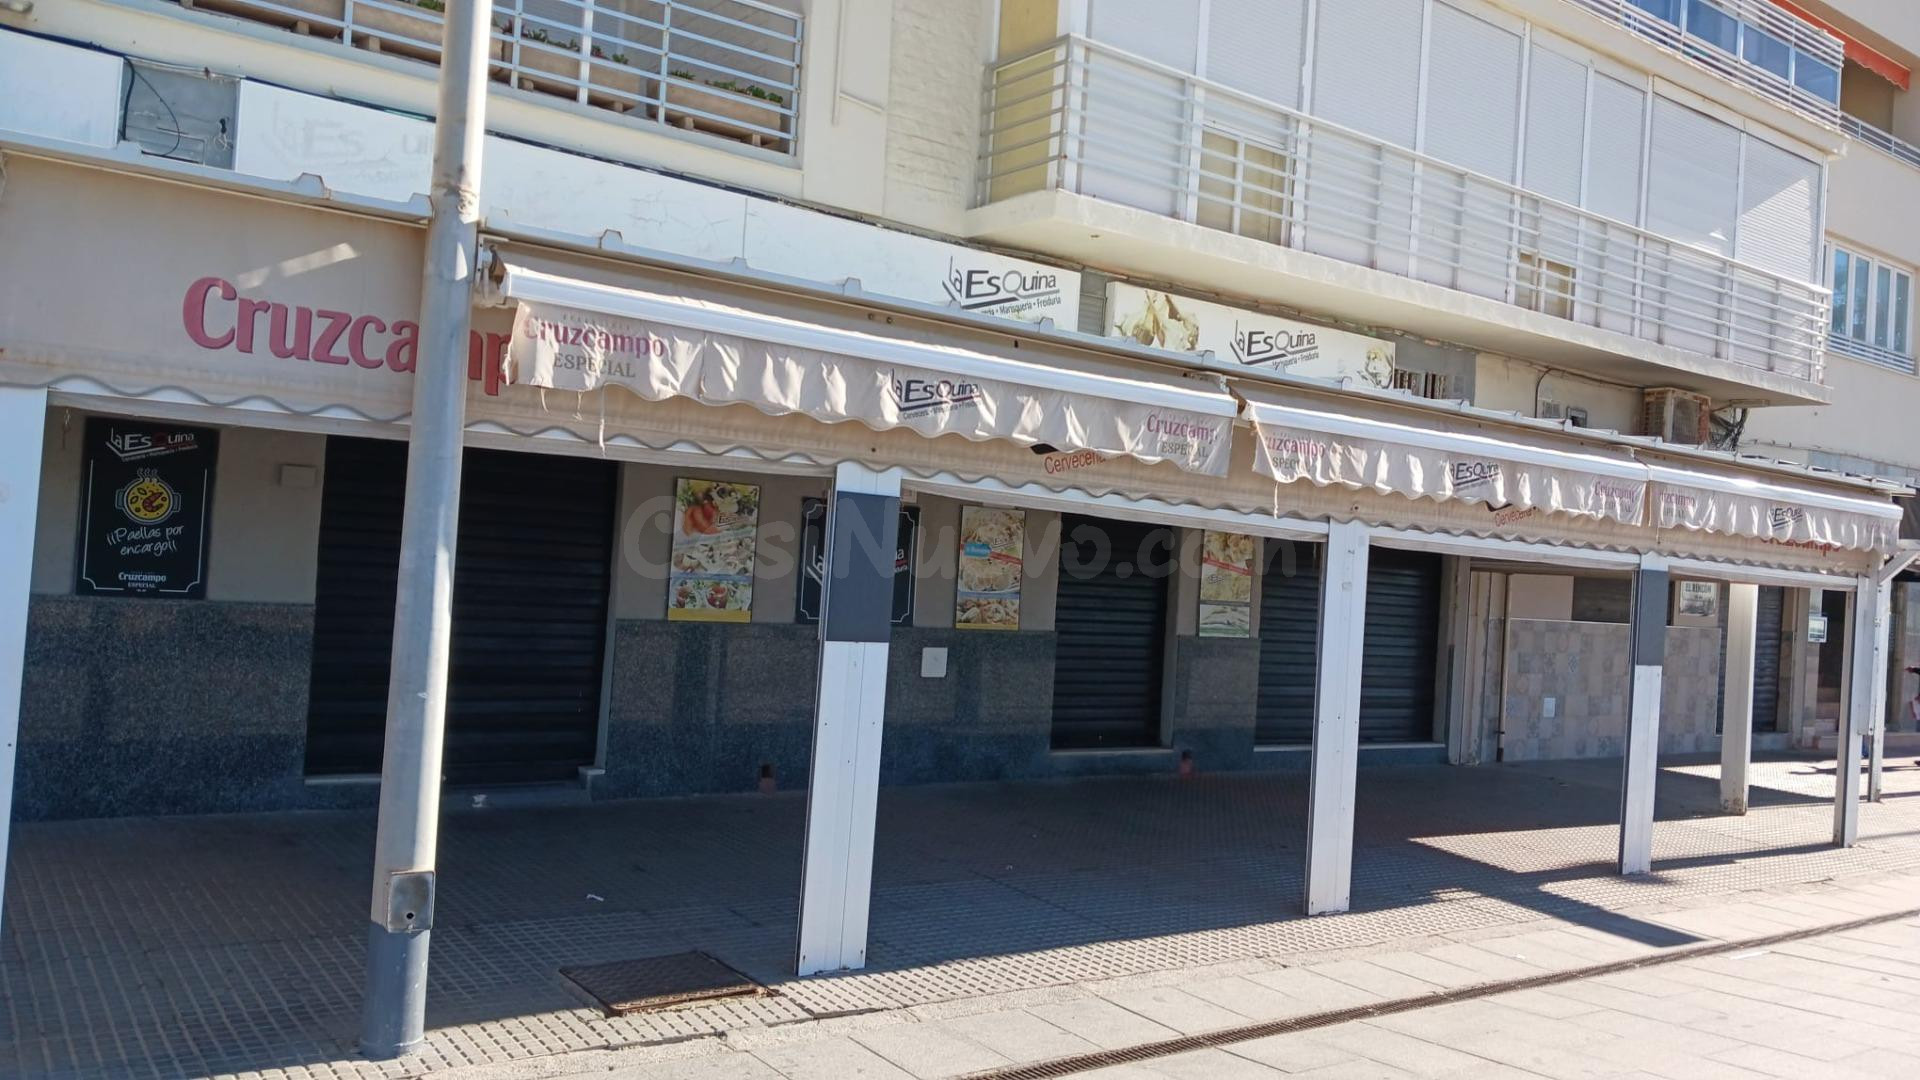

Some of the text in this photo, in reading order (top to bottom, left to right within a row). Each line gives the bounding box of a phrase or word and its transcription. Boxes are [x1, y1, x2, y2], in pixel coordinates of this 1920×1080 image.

[965, 269, 1059, 300] EsQuina
[182, 276, 516, 397] Cruzcap
[1247, 330, 1318, 357] EsQuina
[904, 379, 979, 403] EsQuina
[1146, 414, 1217, 445] Cruzcam
[165, 524, 185, 540] por
[118, 571, 167, 583] Cruzcampo
